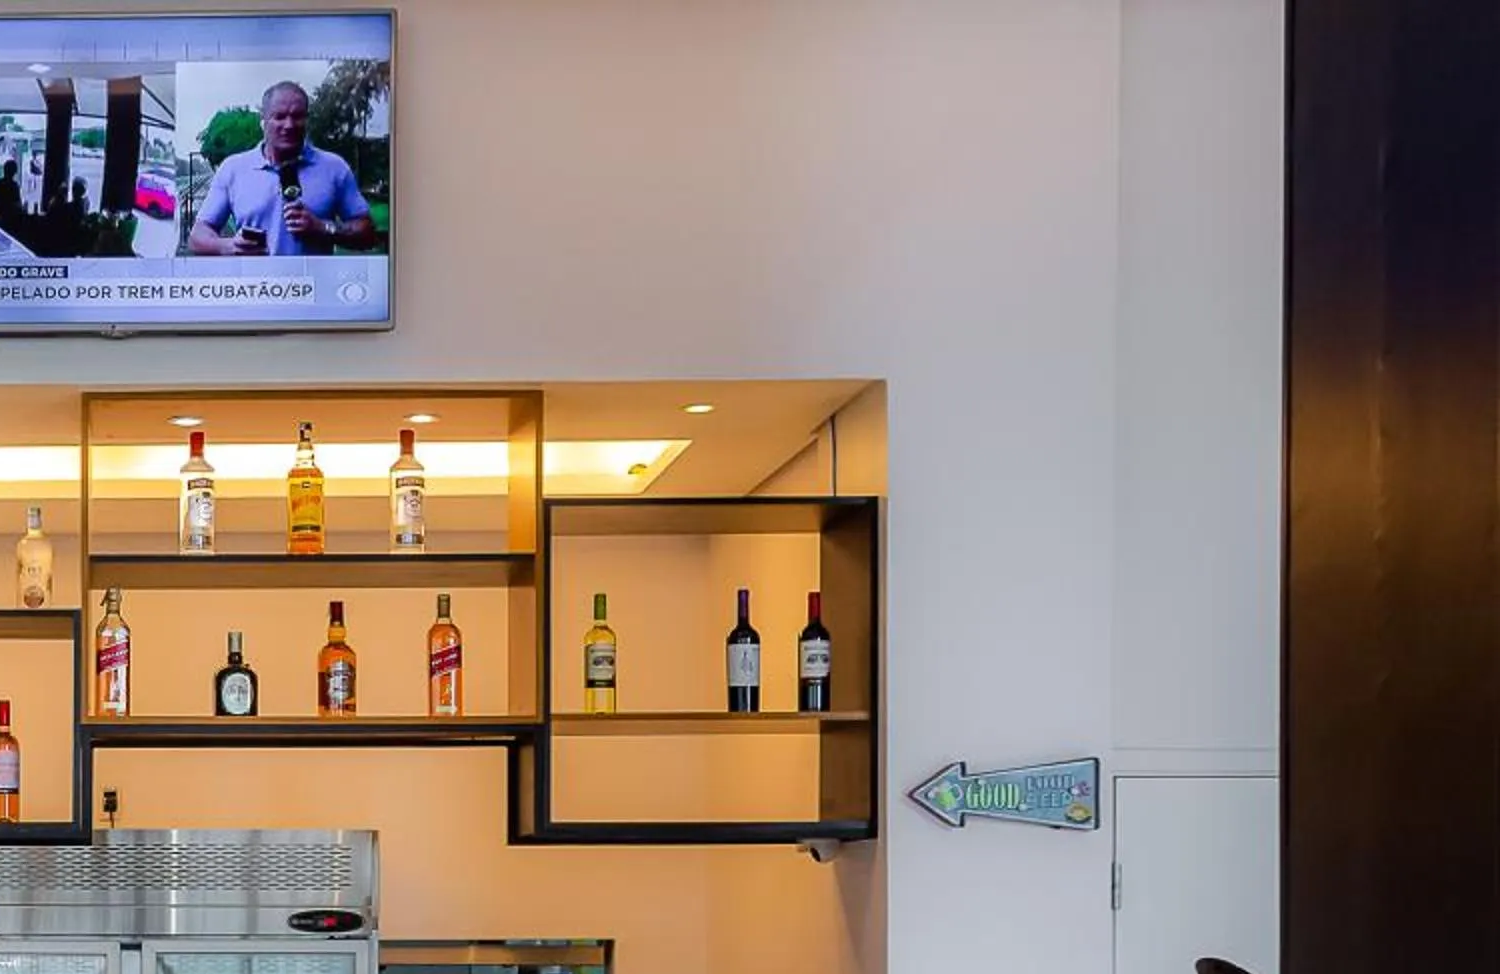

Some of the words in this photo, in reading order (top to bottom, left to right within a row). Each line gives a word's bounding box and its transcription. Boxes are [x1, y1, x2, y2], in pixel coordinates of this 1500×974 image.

[20, 267, 65, 278] GRAVE
[75, 285, 112, 299] POR
[117, 285, 164, 299] TREM
[169, 284, 195, 299] EM
[199, 281, 313, 299] CUBATÃO/SP
[965, 782, 1021, 810] GOOD
